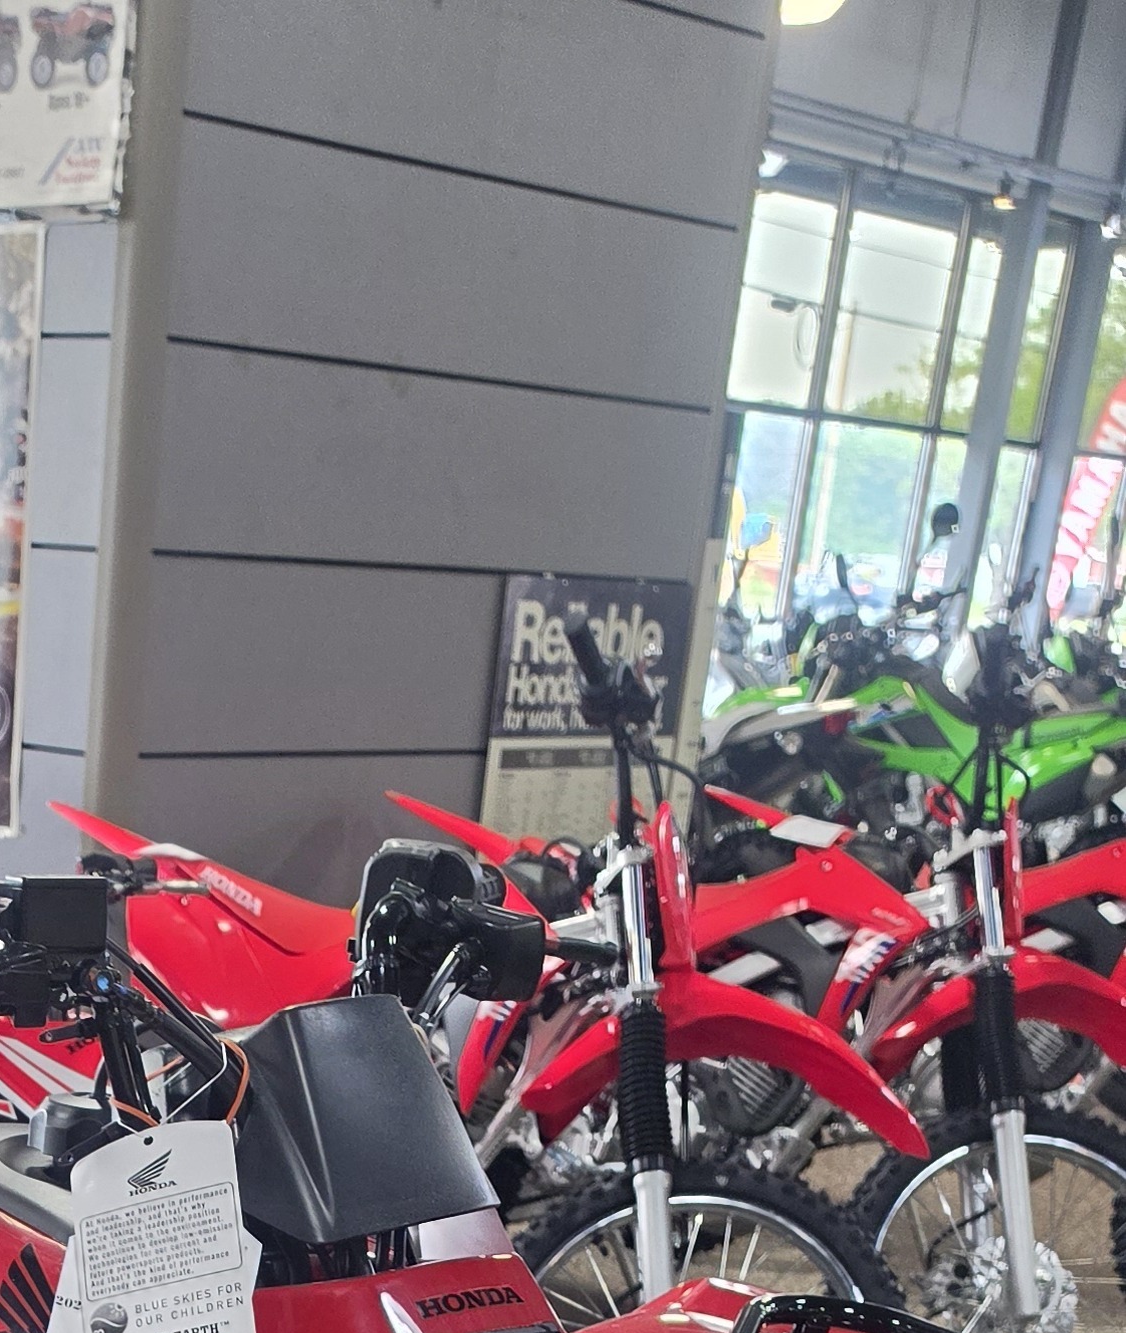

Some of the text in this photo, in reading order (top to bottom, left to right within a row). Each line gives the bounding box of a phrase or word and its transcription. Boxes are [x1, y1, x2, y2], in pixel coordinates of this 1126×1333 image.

[510, 599, 665, 664] Reable
[129, 1180, 177, 1197] HONDA
[179, 1188, 228, 1206] performance
[179, 1250, 230, 1268] performance
[55, 1294, 82, 1311] 202
[134, 1282, 243, 1315] BLUE SKIES FOR
[415, 1286, 525, 1319] HONDA
[135, 1296, 245, 1329] OUR CHILDREN
